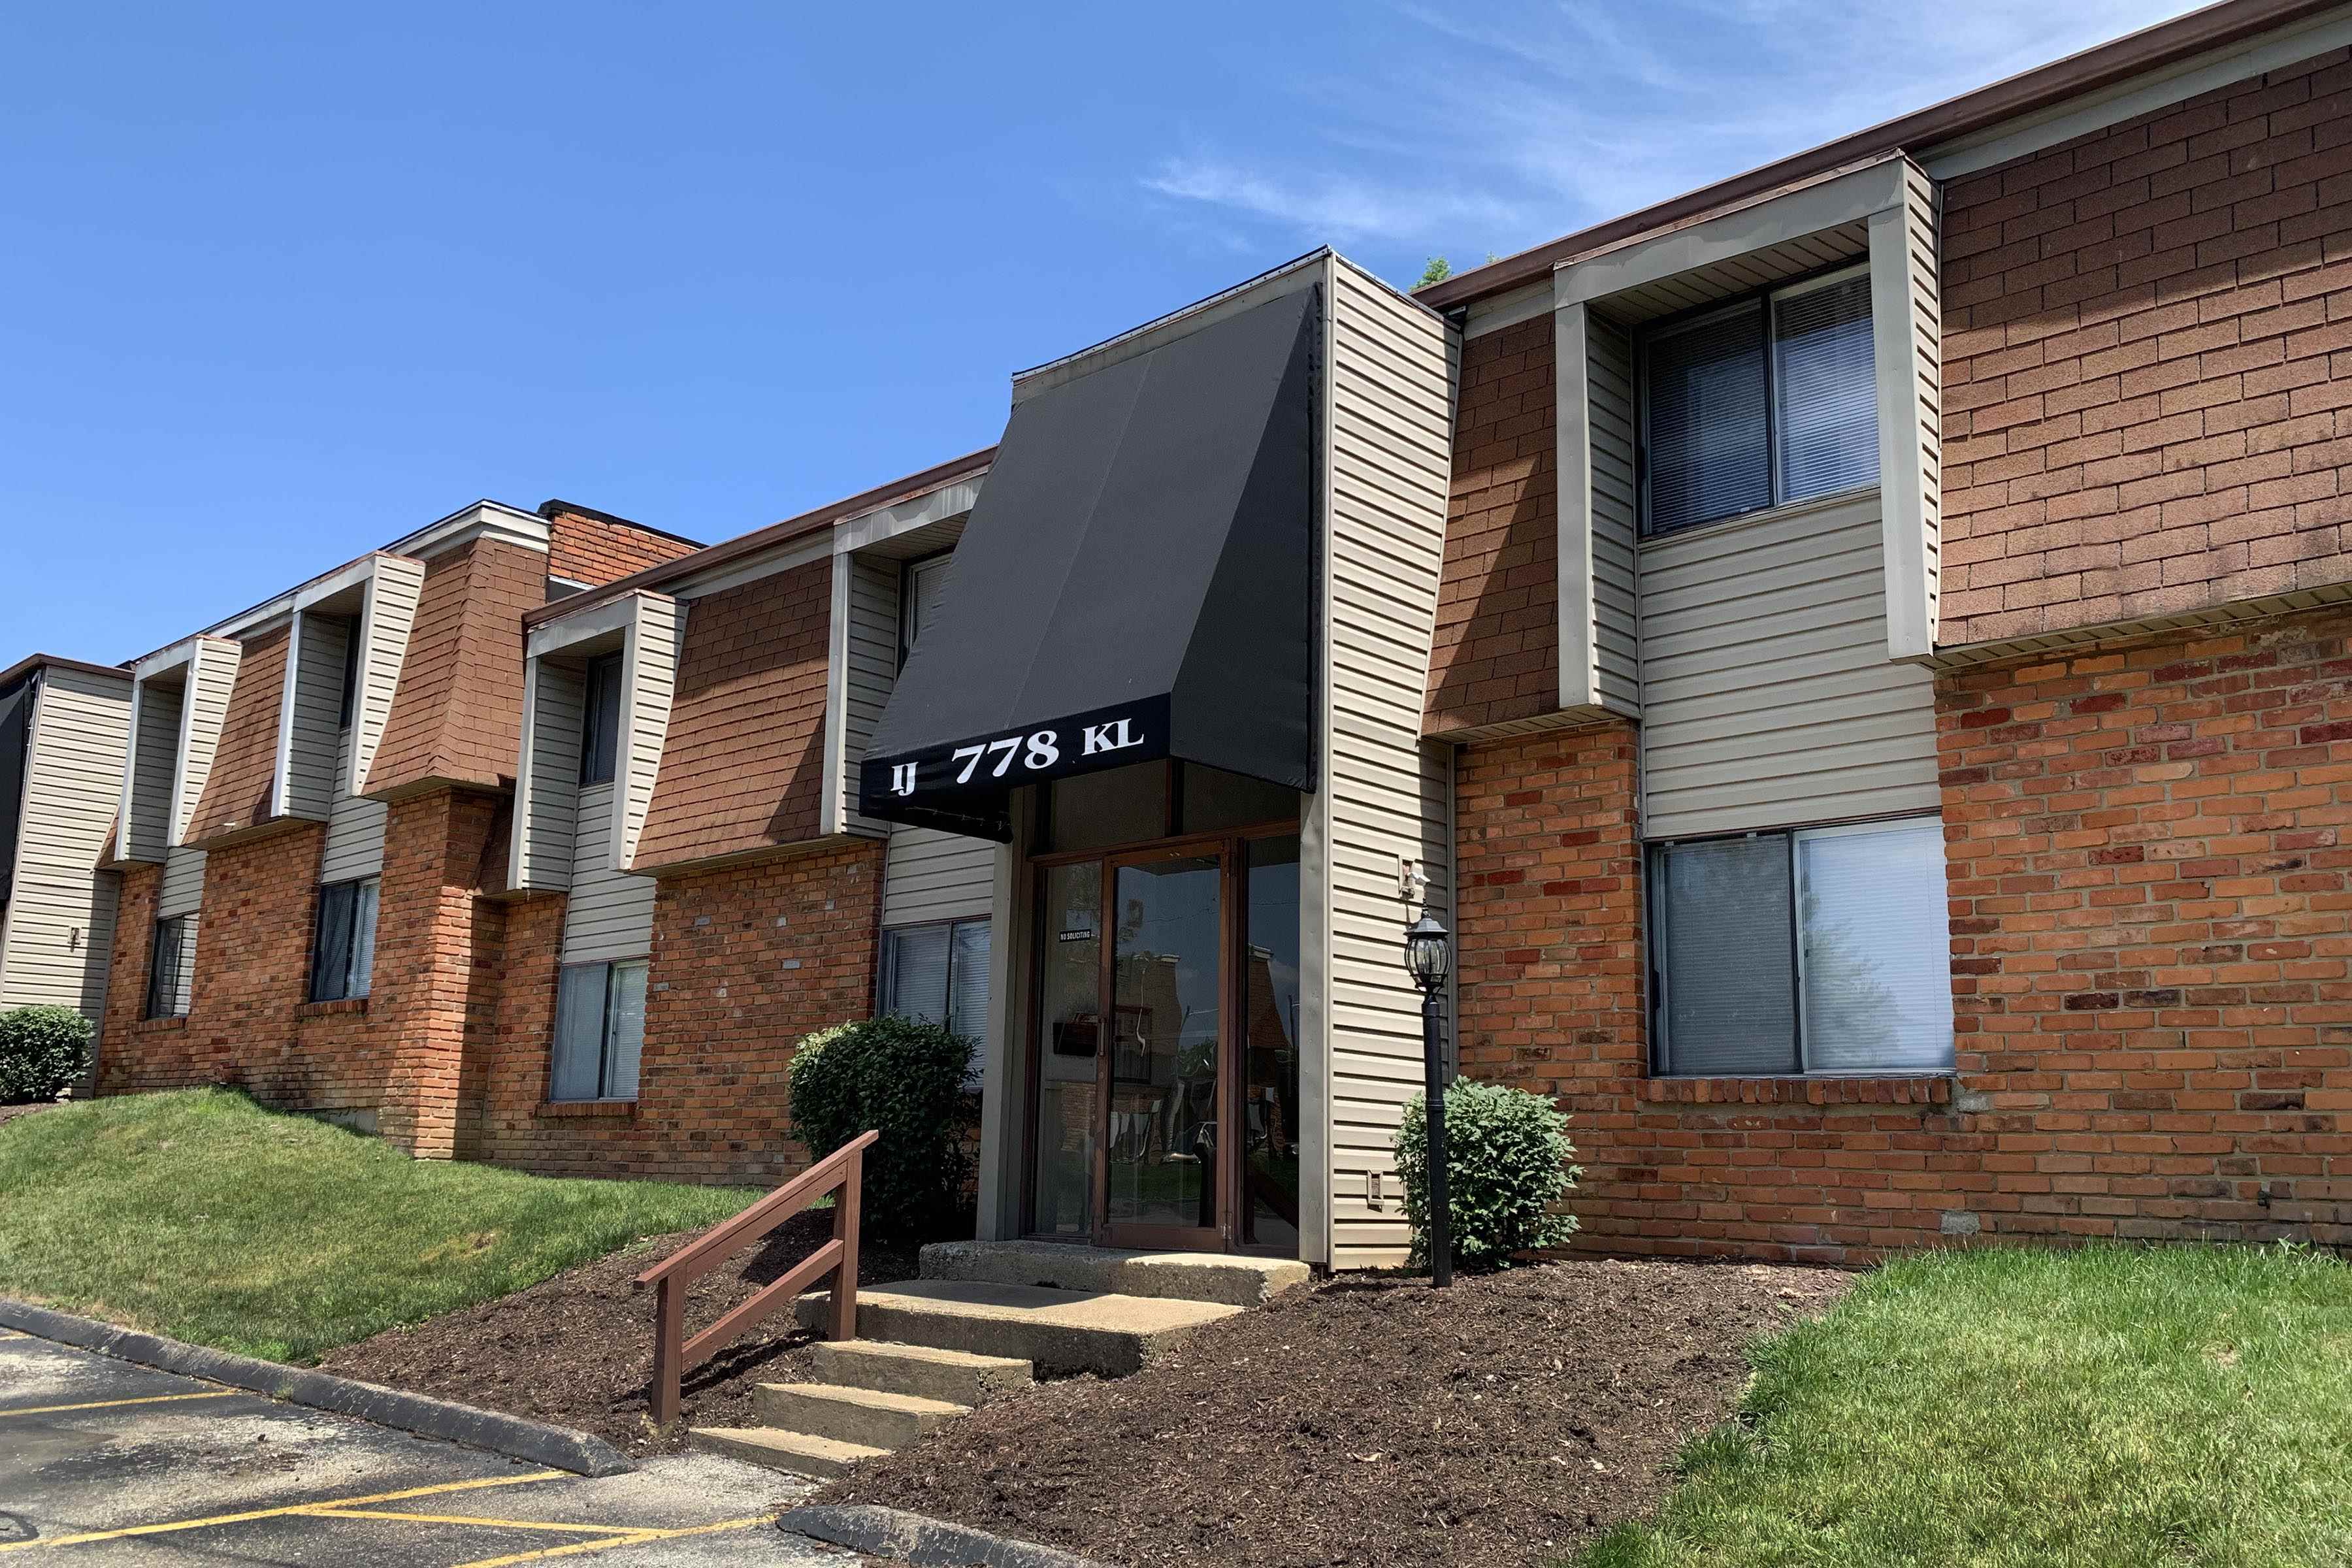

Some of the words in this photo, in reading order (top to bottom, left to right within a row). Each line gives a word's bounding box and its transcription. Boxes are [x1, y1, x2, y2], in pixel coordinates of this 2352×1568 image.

[890, 762, 919, 796] IJ
[951, 730, 1059, 784] 778
[1081, 718, 1144, 756] KL
[1067, 931, 1090, 939] SOLICITING
